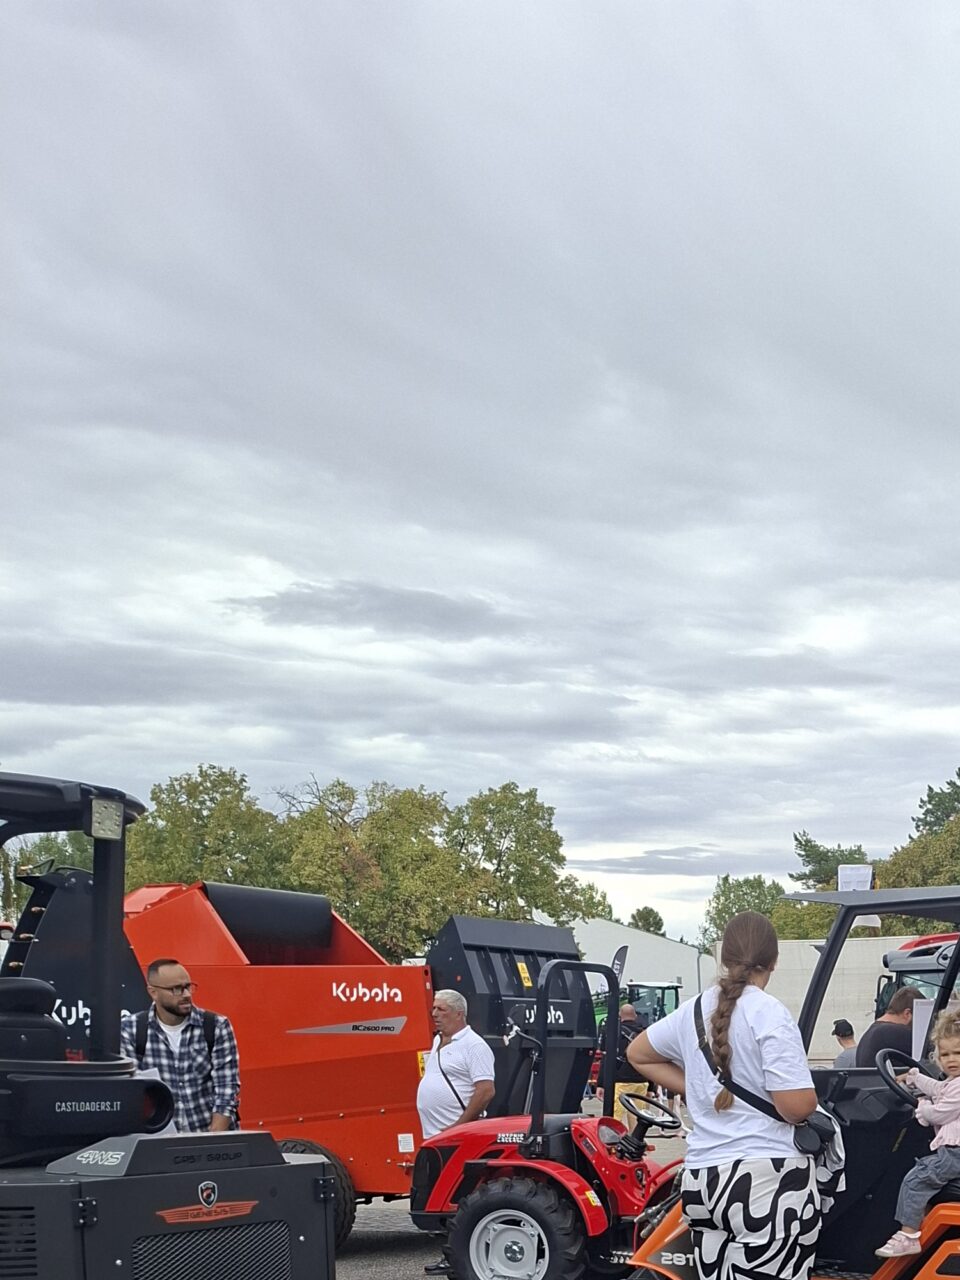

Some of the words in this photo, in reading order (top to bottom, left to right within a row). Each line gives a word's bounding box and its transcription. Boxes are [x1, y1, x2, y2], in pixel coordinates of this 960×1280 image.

[332, 982, 403, 1003] Kubota
[55, 1101, 121, 1112] CASTLOADERS.IT
[76, 1150, 126, 1166] 4WS
[206, 1152, 243, 1163] GROUP
[189, 1207, 229, 1219] GENESIS
